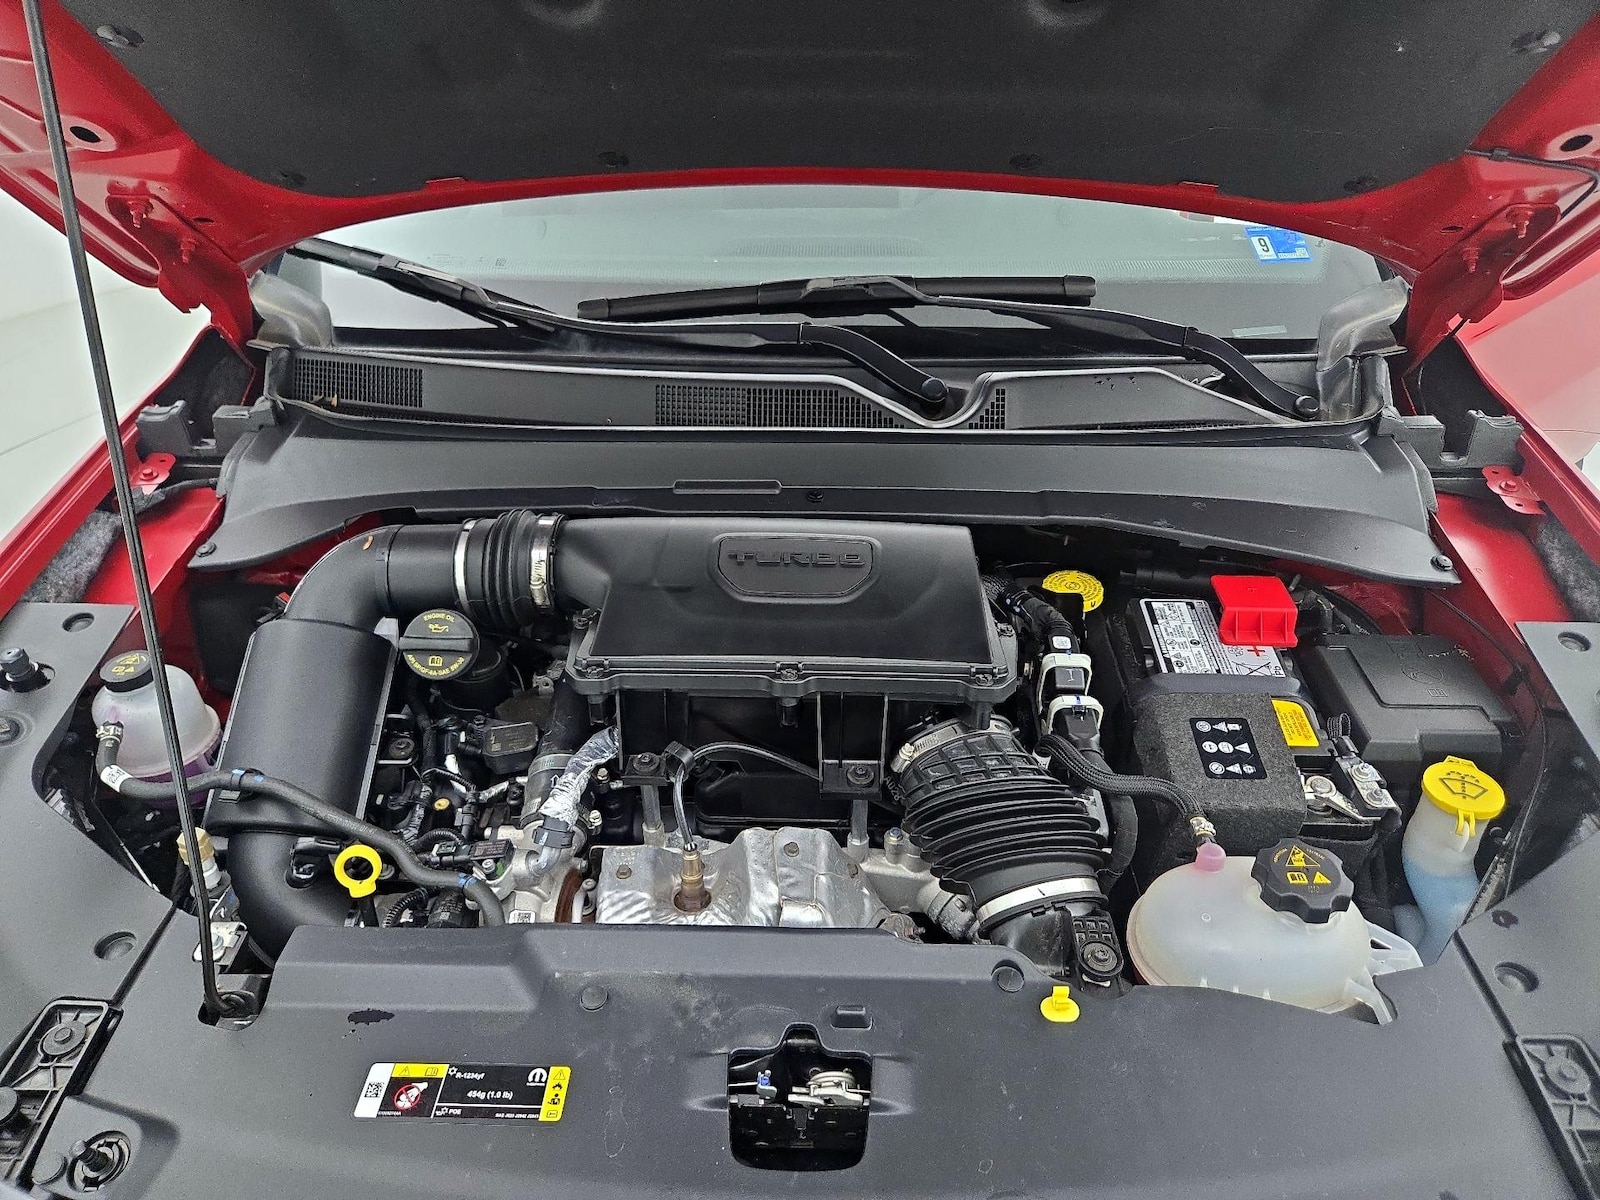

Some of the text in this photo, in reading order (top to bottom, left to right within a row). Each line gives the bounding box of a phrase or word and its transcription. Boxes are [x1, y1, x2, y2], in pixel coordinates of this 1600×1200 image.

[1257, 238, 1270, 253] 9
[728, 551, 866, 567] TURBO
[423, 613, 446, 621] ENGINE
[1273, 665, 1282, 677] Pb
[455, 1072, 485, 1080] R-1234yf
[467, 1090, 513, 1100] 454g (1.0 lb)
